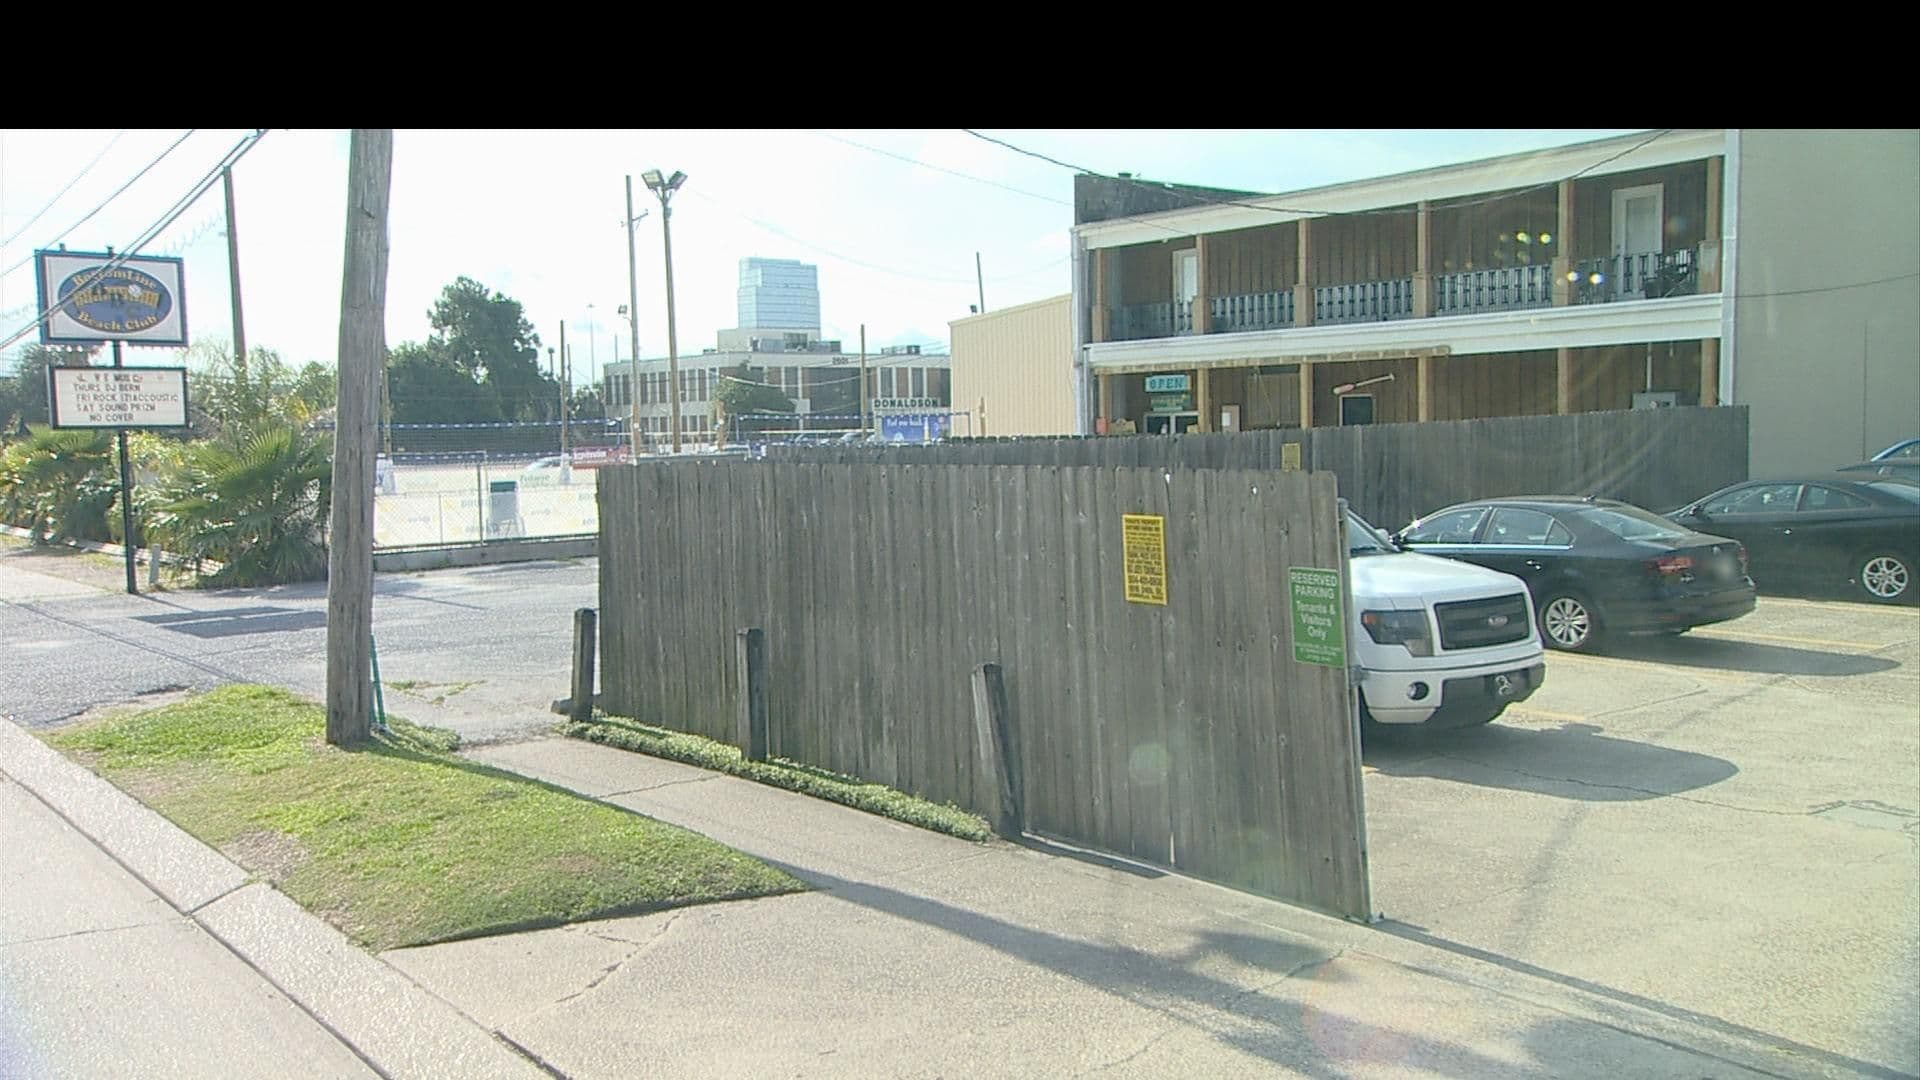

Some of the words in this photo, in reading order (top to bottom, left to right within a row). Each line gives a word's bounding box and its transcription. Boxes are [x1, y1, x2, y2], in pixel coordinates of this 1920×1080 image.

[79, 311, 121, 330] Beach
[125, 314, 158, 330] Club
[105, 383, 117, 392] DJ
[1150, 378, 1183, 389] OPEN
[76, 393, 91, 402] FRI
[93, 393, 117, 402] ROCK
[100, 403, 129, 412] SOUND
[873, 399, 938, 408] DONALDSON
[89, 414, 103, 422] NO
[105, 413, 135, 421] COVER
[1291, 572, 1337, 587] RESERVED
[1296, 585, 1335, 599] PARKING
[1301, 613, 1332, 627] Visitors
[1307, 625, 1327, 641] Only
